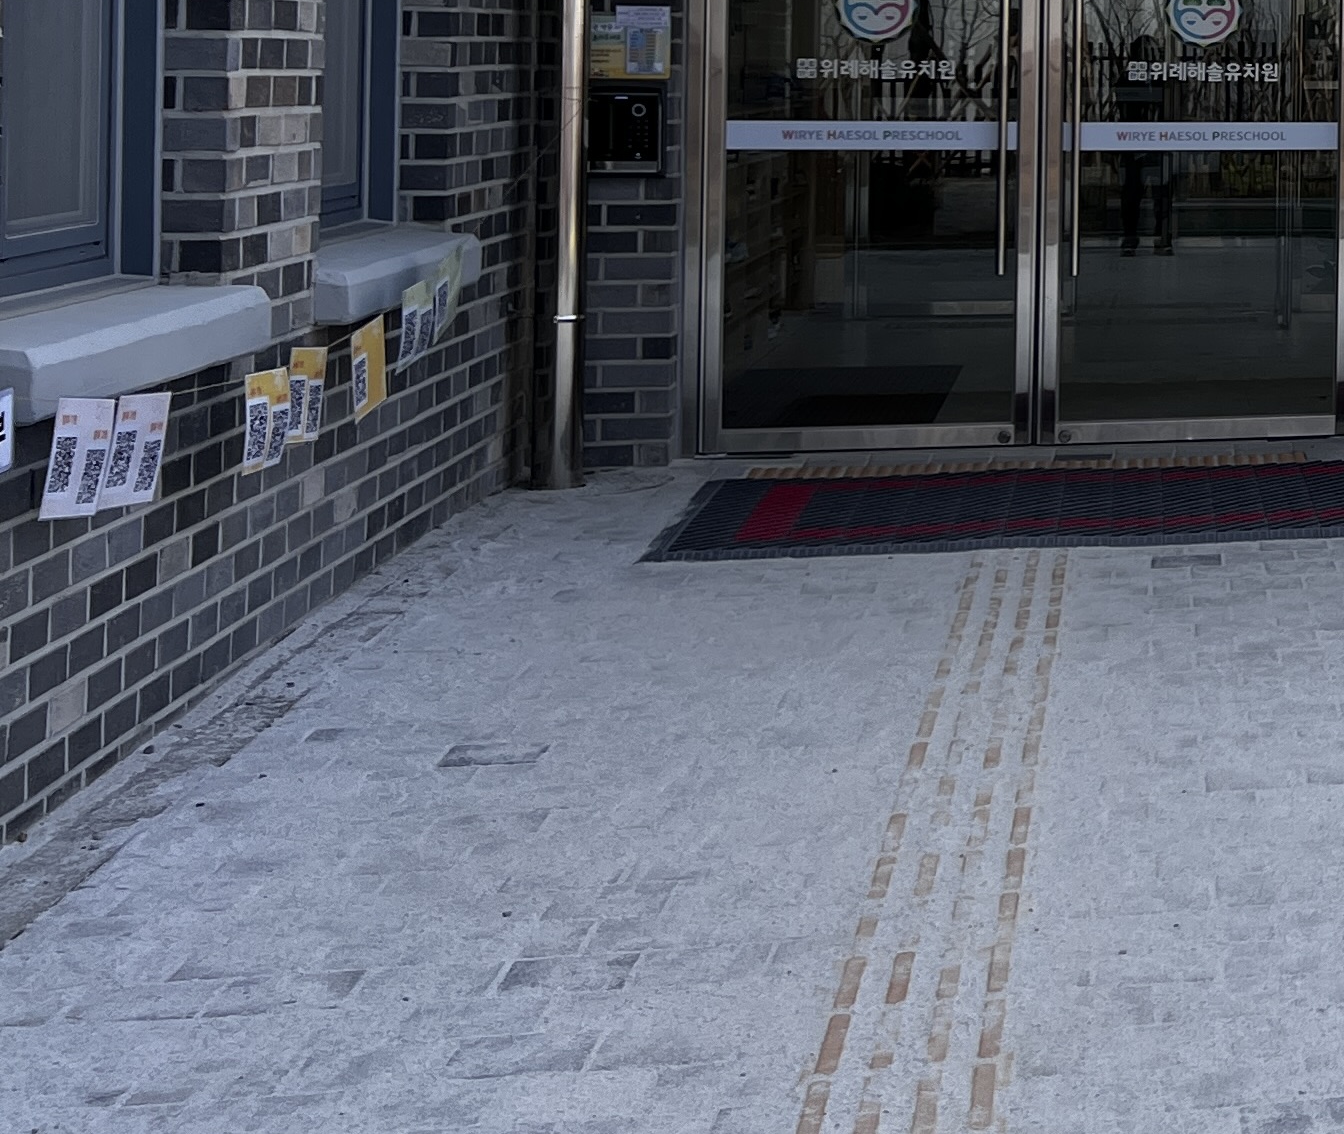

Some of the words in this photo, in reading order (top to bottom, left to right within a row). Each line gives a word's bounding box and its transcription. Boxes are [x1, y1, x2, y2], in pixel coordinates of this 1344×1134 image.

[819, 59, 956, 80] 위례해솔유치원
[1150, 62, 1280, 83] 위례해솔유치원
[781, 129, 824, 141] WIRYE
[826, 129, 880, 141] HAESOL
[882, 129, 963, 141] PRESCHOOL
[1116, 131, 1156, 142] WIRYE
[1159, 131, 1208, 142] HAESOL
[1212, 131, 1287, 142] PRESCHOOL
